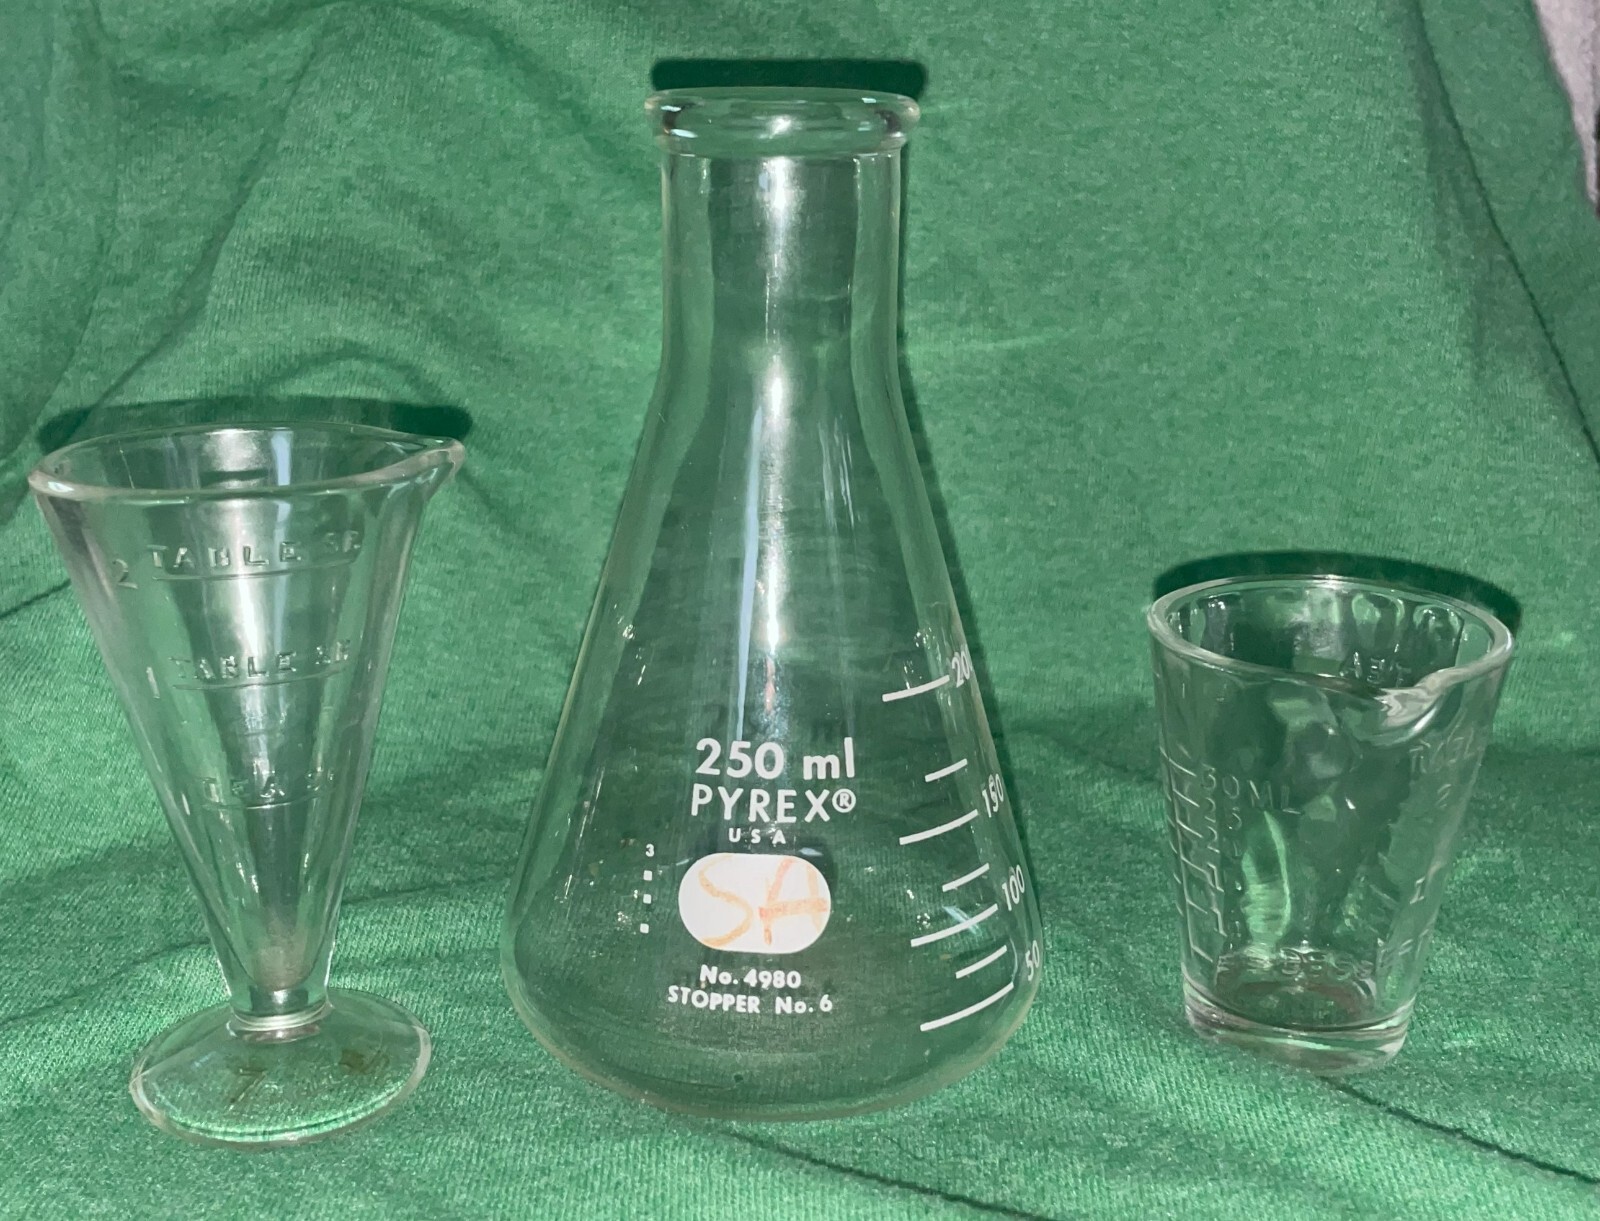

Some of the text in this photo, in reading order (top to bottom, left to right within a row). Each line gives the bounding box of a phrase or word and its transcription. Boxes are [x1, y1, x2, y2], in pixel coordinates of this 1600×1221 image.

[147, 540, 302, 570] TABLE
[168, 651, 297, 680] TABLE
[695, 737, 856, 781] 250 ml
[645, 844, 655, 858] 3
[1024, 939, 1041, 983] 50
[699, 963, 803, 991] No. 4980
[667, 984, 834, 1015] STOPPER No. 6
